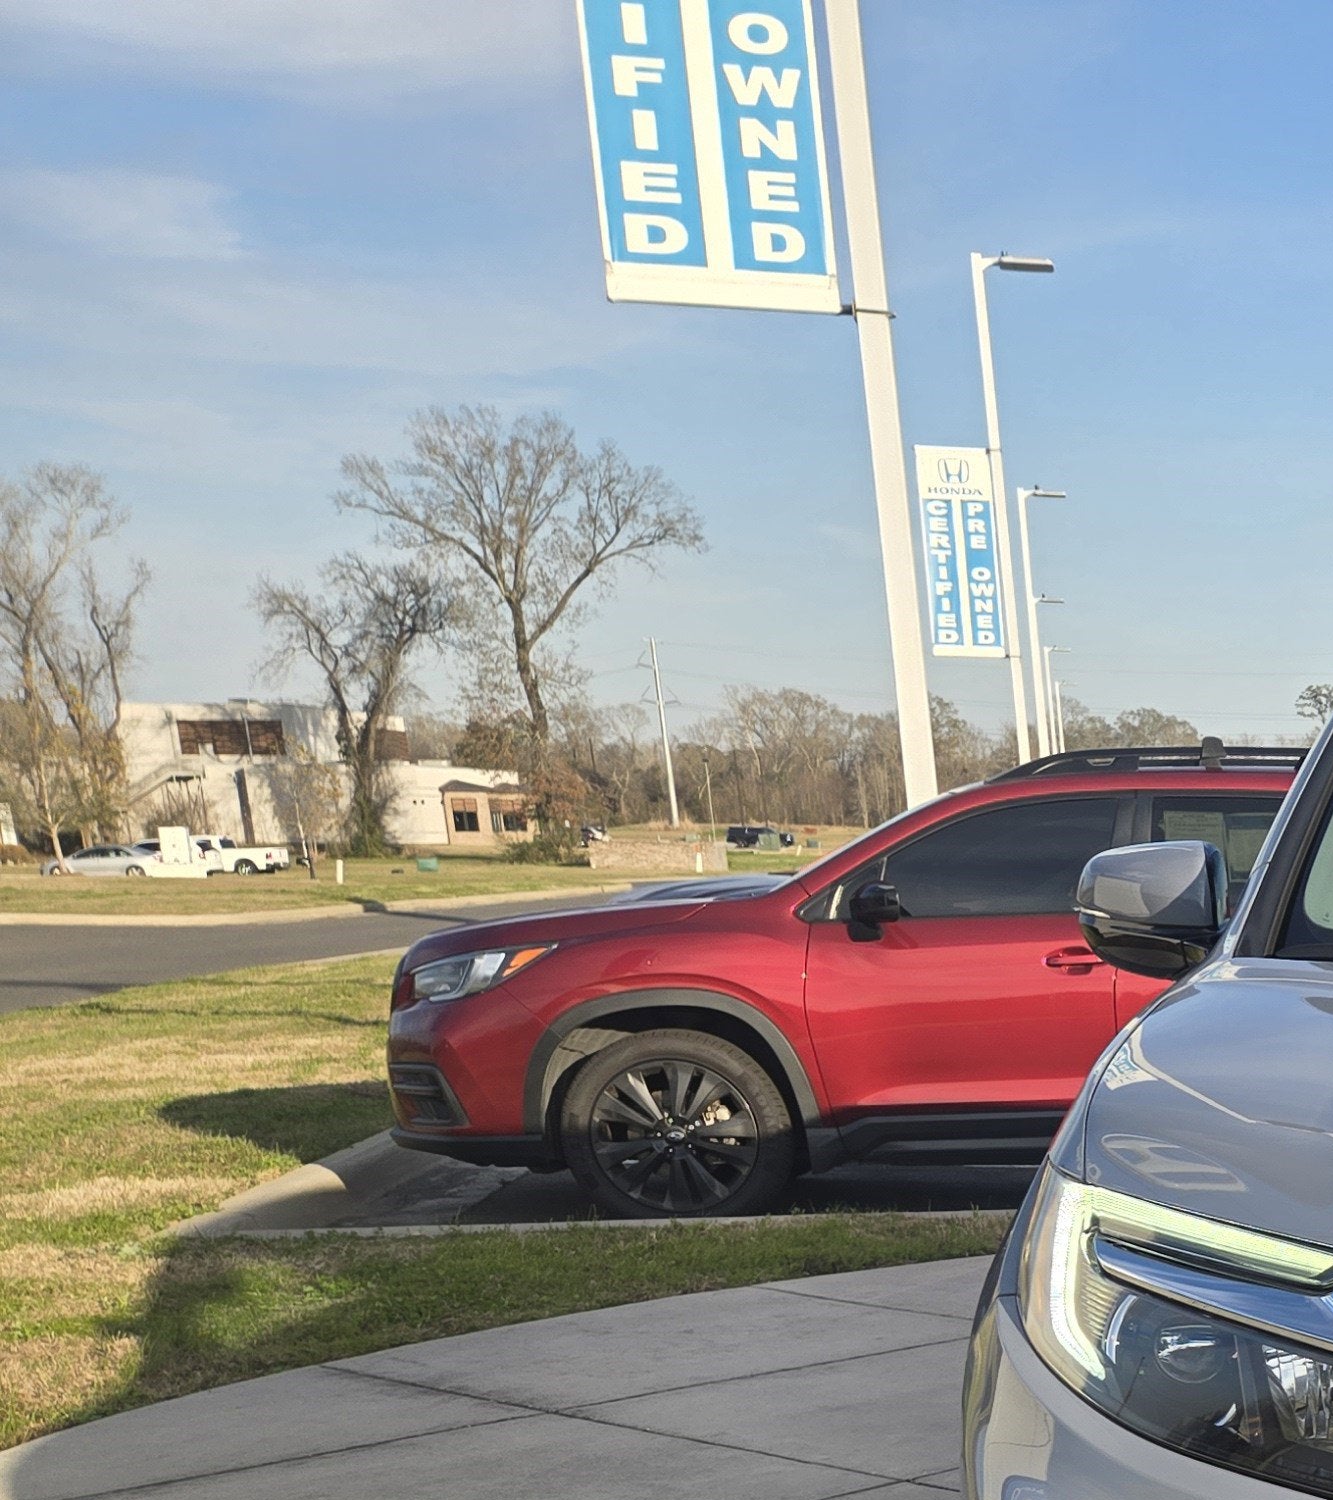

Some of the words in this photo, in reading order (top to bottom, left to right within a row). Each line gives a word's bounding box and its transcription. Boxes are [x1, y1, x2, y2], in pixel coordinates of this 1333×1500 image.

[722, 12, 806, 263] OWNED
[927, 486, 983, 496] HONDA
[967, 502, 987, 550] PRE
[926, 500, 960, 643] CERTIFIED
[970, 566, 996, 645] OWNED
